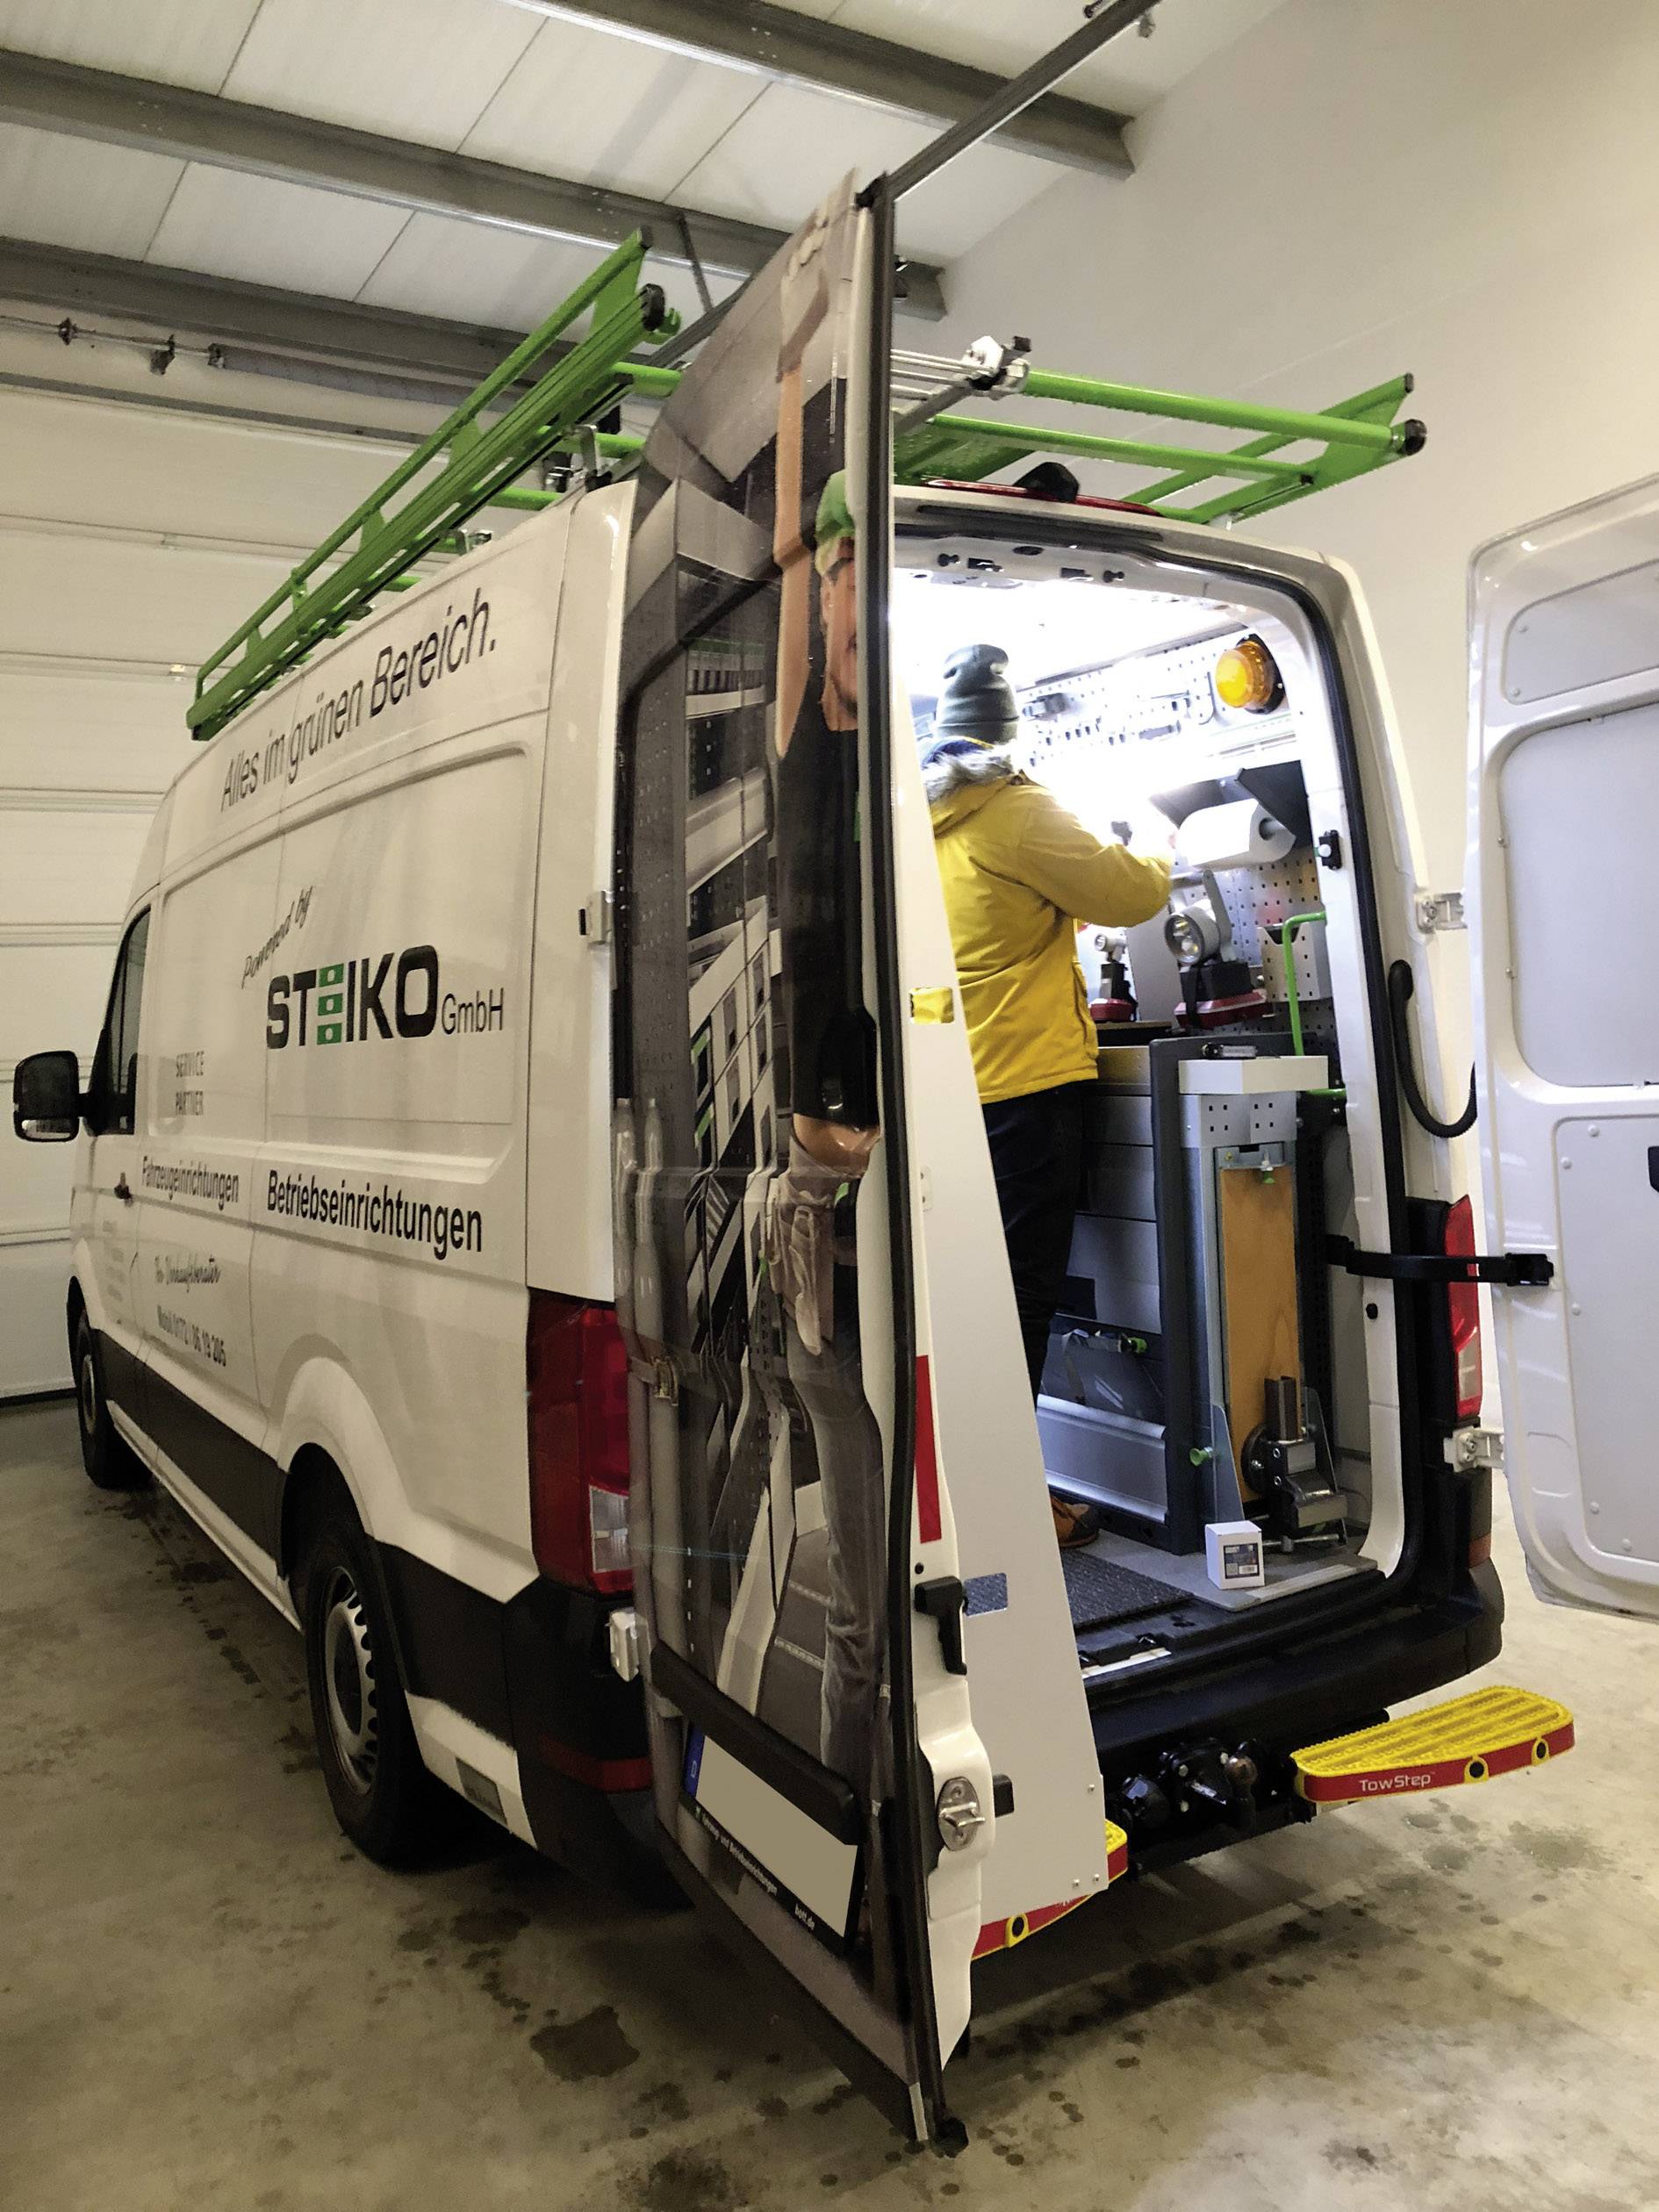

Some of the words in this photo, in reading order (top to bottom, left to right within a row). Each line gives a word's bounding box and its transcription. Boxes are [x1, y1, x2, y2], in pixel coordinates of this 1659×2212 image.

[220, 749, 259, 813] Alles
[263, 729, 285, 785] im
[287, 679, 363, 784] grünen
[370, 586, 497, 718] Bereich.
[441, 988, 505, 1035] GmbH
[141, 1155, 239, 1211] Fahrzeugeinrichtungen
[267, 1169, 483, 1260] Betriebseinrichtungen
